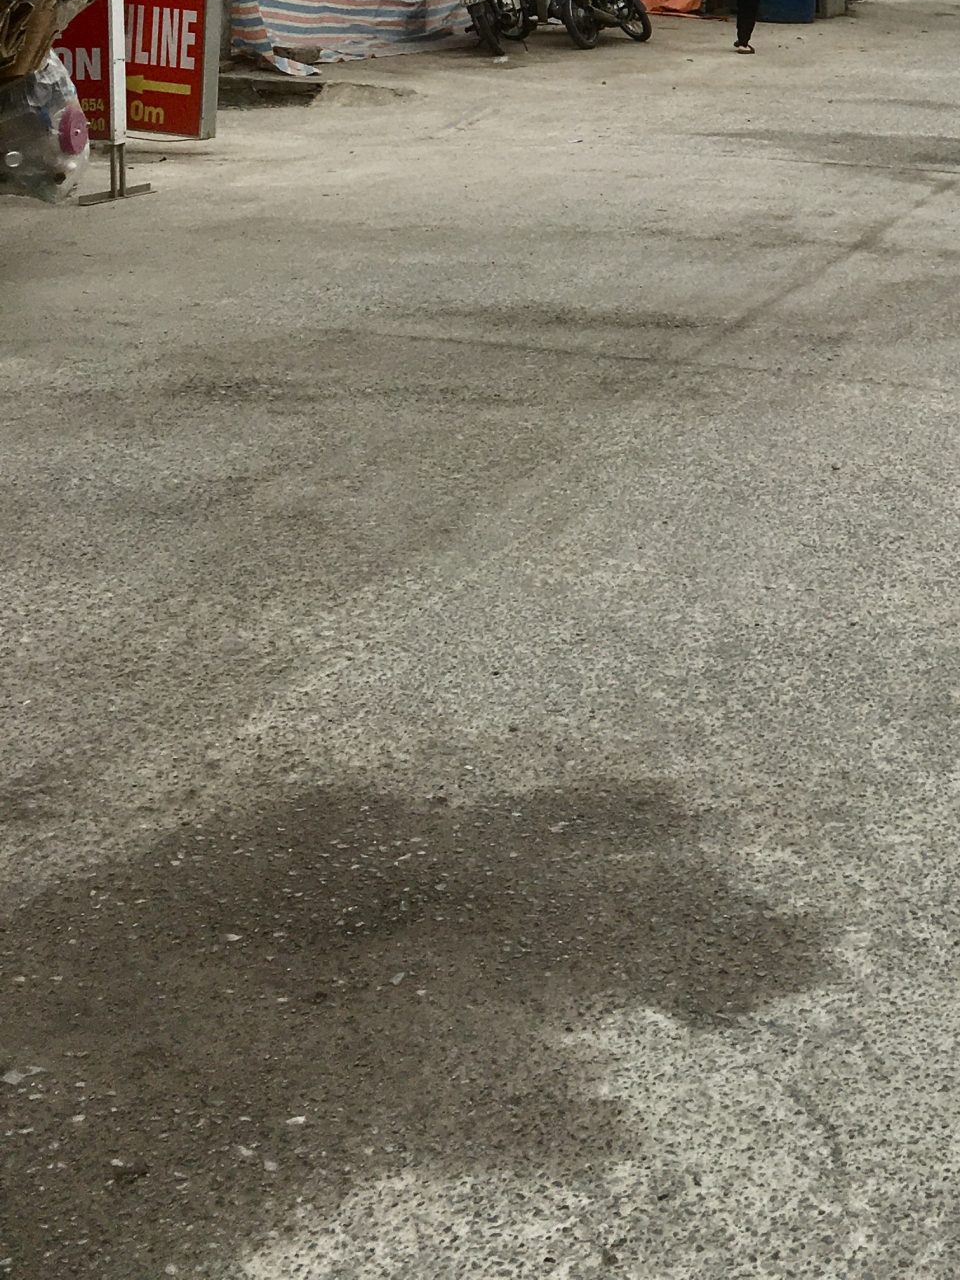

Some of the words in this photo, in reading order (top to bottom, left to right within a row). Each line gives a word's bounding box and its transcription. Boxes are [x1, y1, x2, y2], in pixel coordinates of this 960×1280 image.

[125, 3, 198, 70] NLINE
[81, 98, 105, 112] 654
[129, 99, 165, 125] 0m
